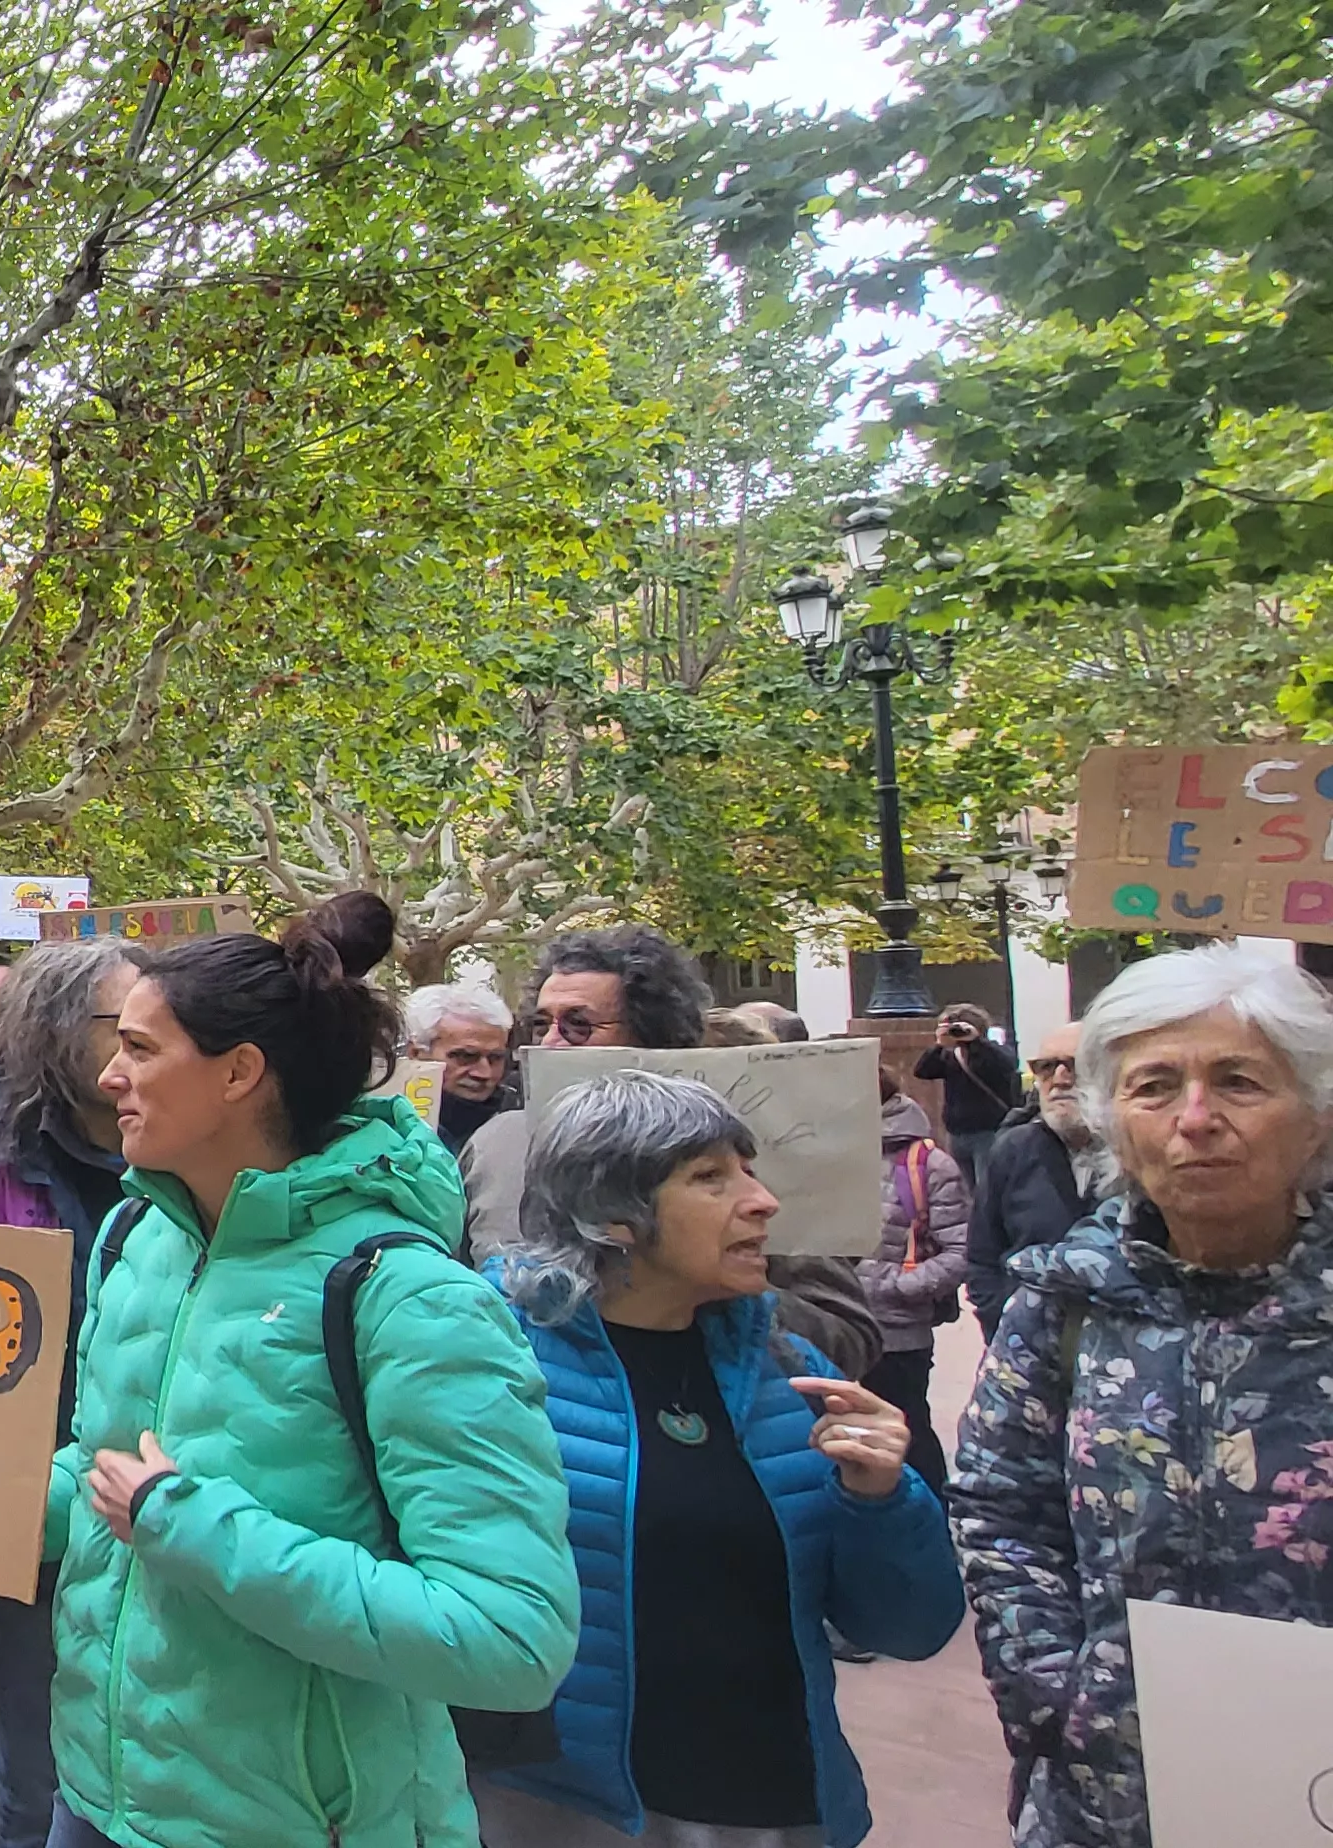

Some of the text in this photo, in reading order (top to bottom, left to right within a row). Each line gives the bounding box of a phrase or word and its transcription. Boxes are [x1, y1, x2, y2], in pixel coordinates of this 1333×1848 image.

[1114, 753, 1226, 809] EL
[1116, 814, 1333, 868] LE S
[109, 906, 216, 939] ESCUELA
